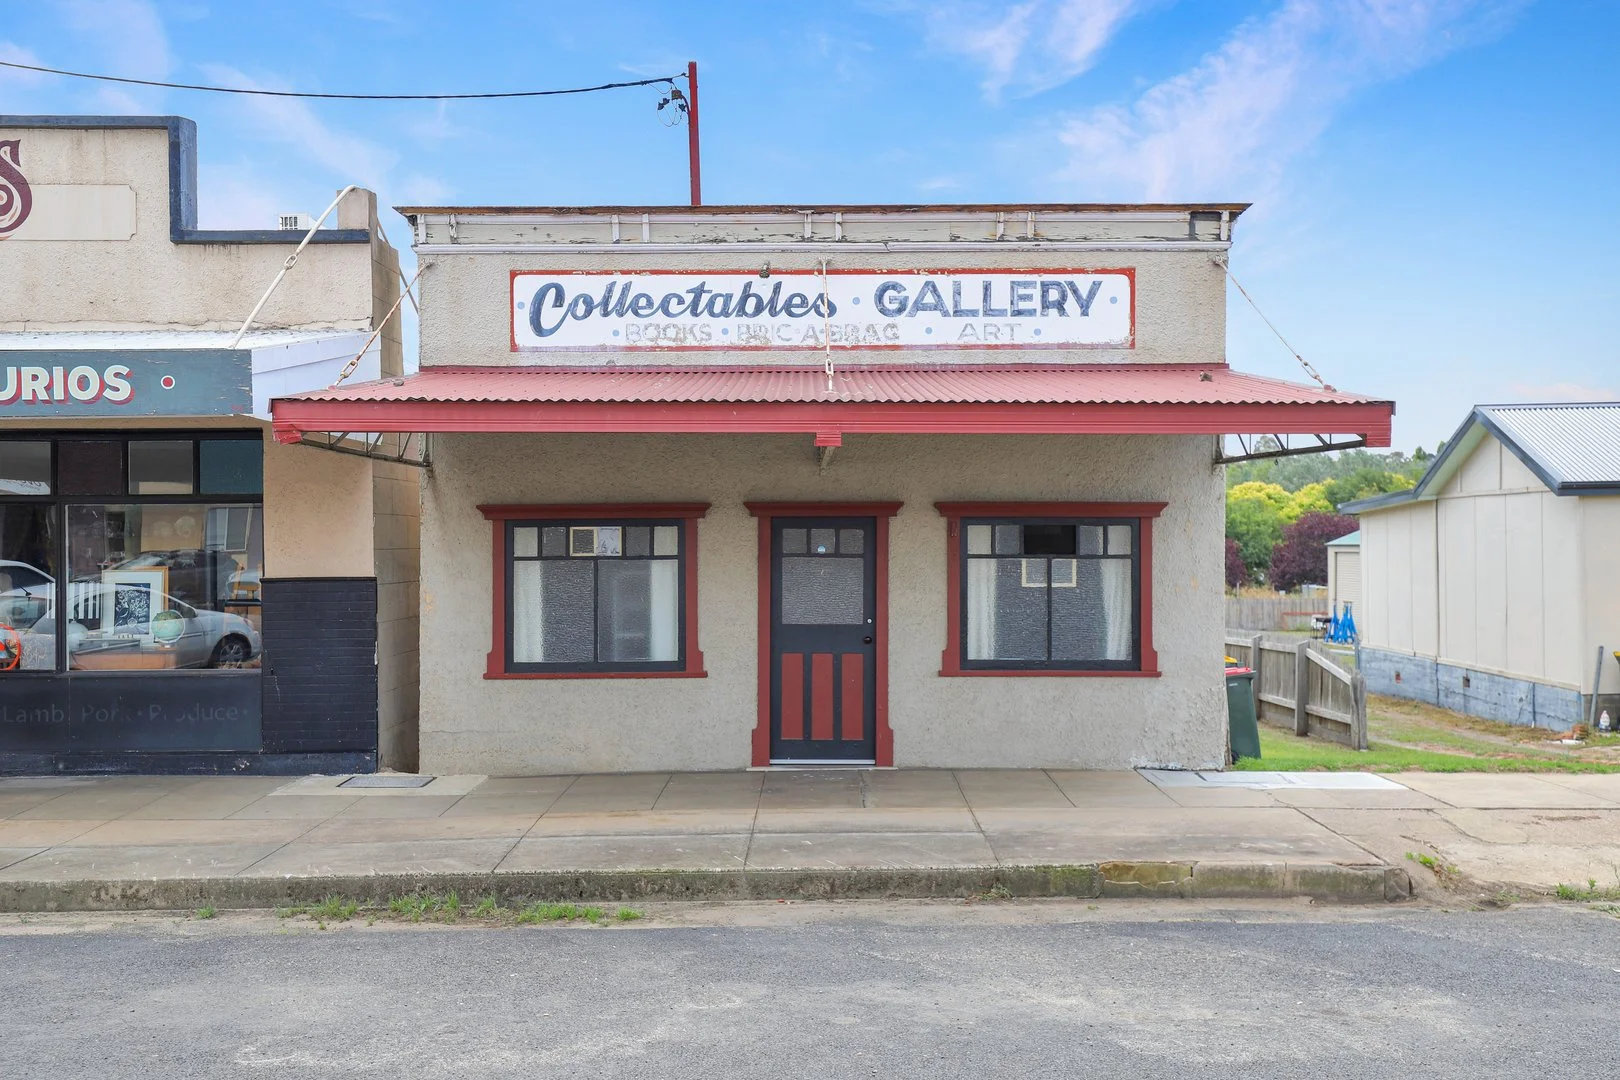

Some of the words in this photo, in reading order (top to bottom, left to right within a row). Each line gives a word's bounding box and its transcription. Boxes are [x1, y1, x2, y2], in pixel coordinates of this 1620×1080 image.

[528, 280, 837, 337] Collectables
[873, 279, 1103, 318] GALLERY
[625, 322, 713, 345] BOOKS
[957, 322, 1022, 342] ART
[2, 703, 66, 724] Lamb
[150, 701, 239, 724] Pduce
